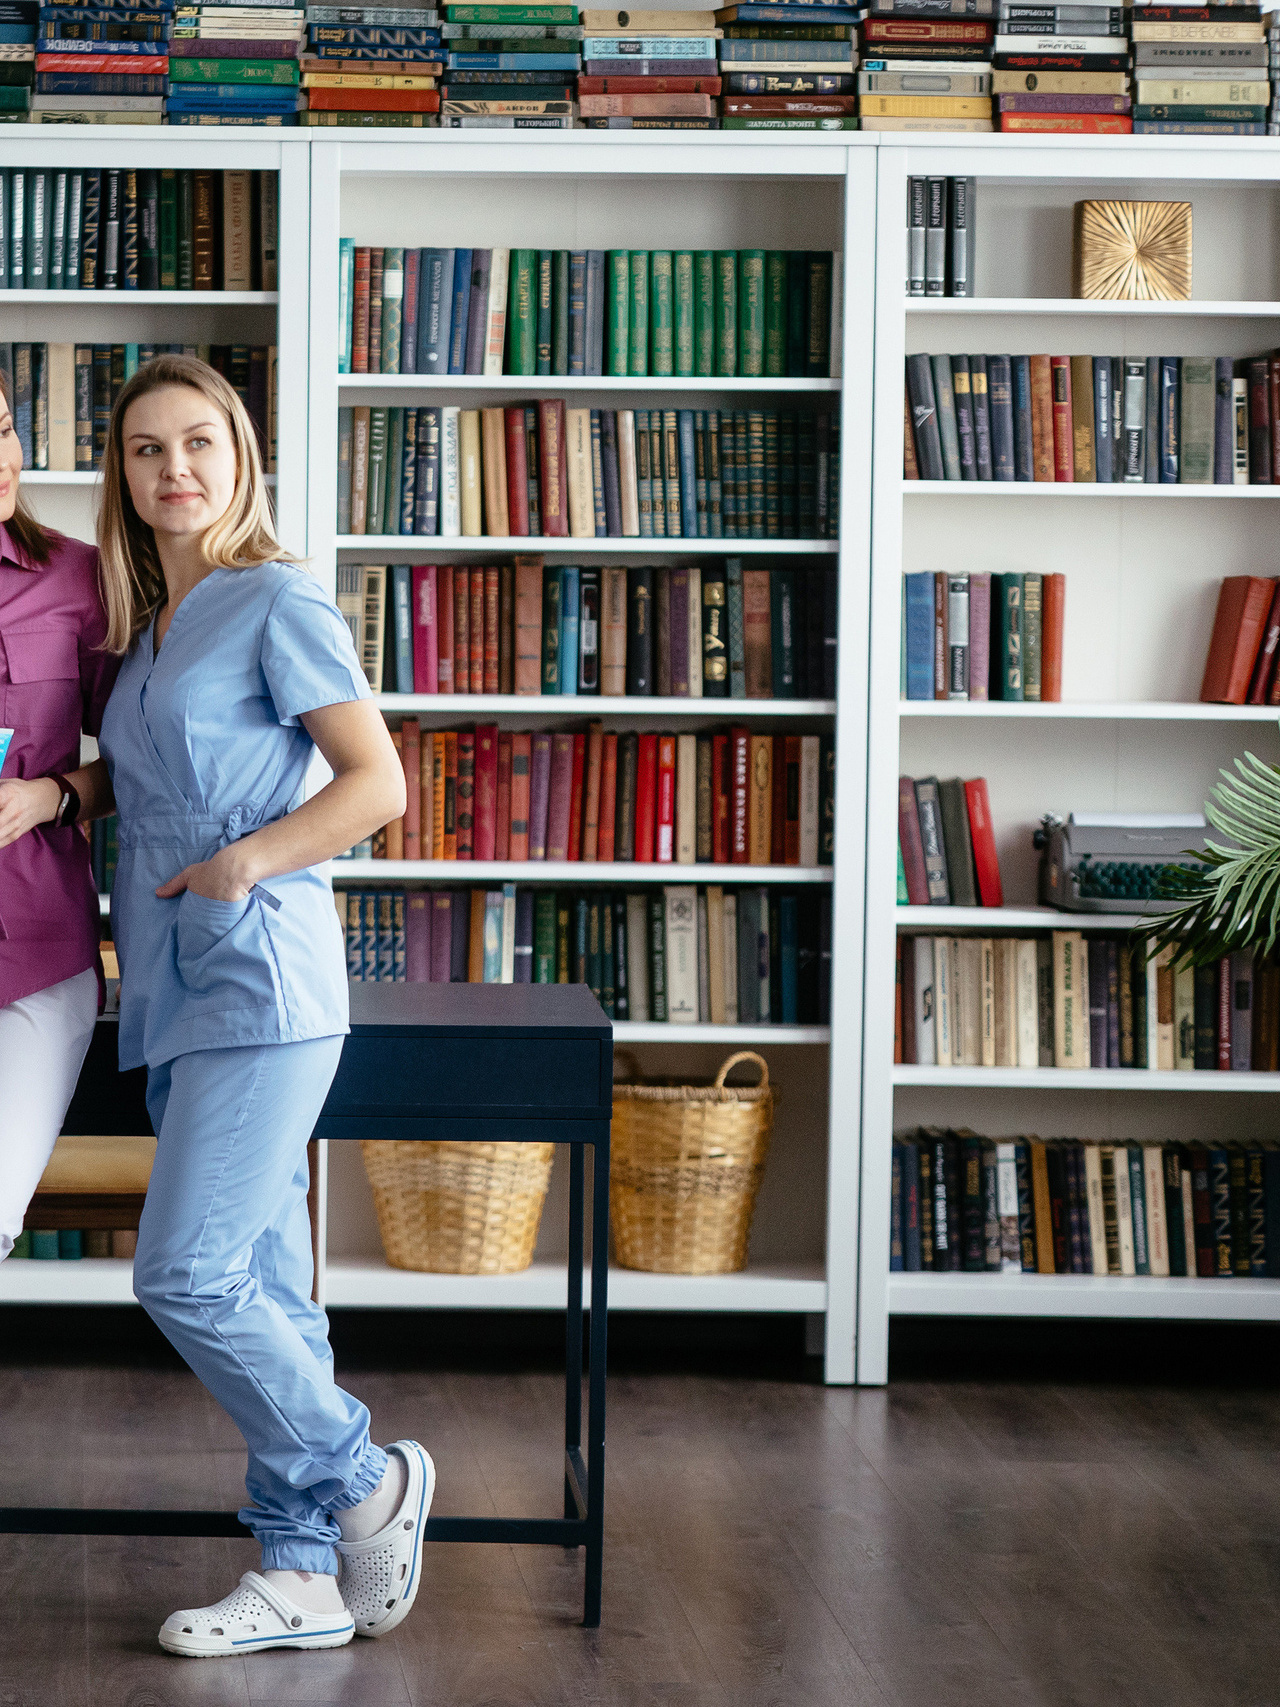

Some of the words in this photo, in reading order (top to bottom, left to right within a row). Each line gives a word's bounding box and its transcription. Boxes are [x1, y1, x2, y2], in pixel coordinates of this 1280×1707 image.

[497, 102, 539, 112] БАЙРОН
[912, 181, 923, 225] М.ГОРЬКИЙ
[931, 182, 941, 226] М.ГОРЬКИЙ
[519, 268, 529, 319] СПАРТАК
[541, 259, 550, 309] СТЕНДАЛЬ
[447, 471, 457, 493] ПОД
